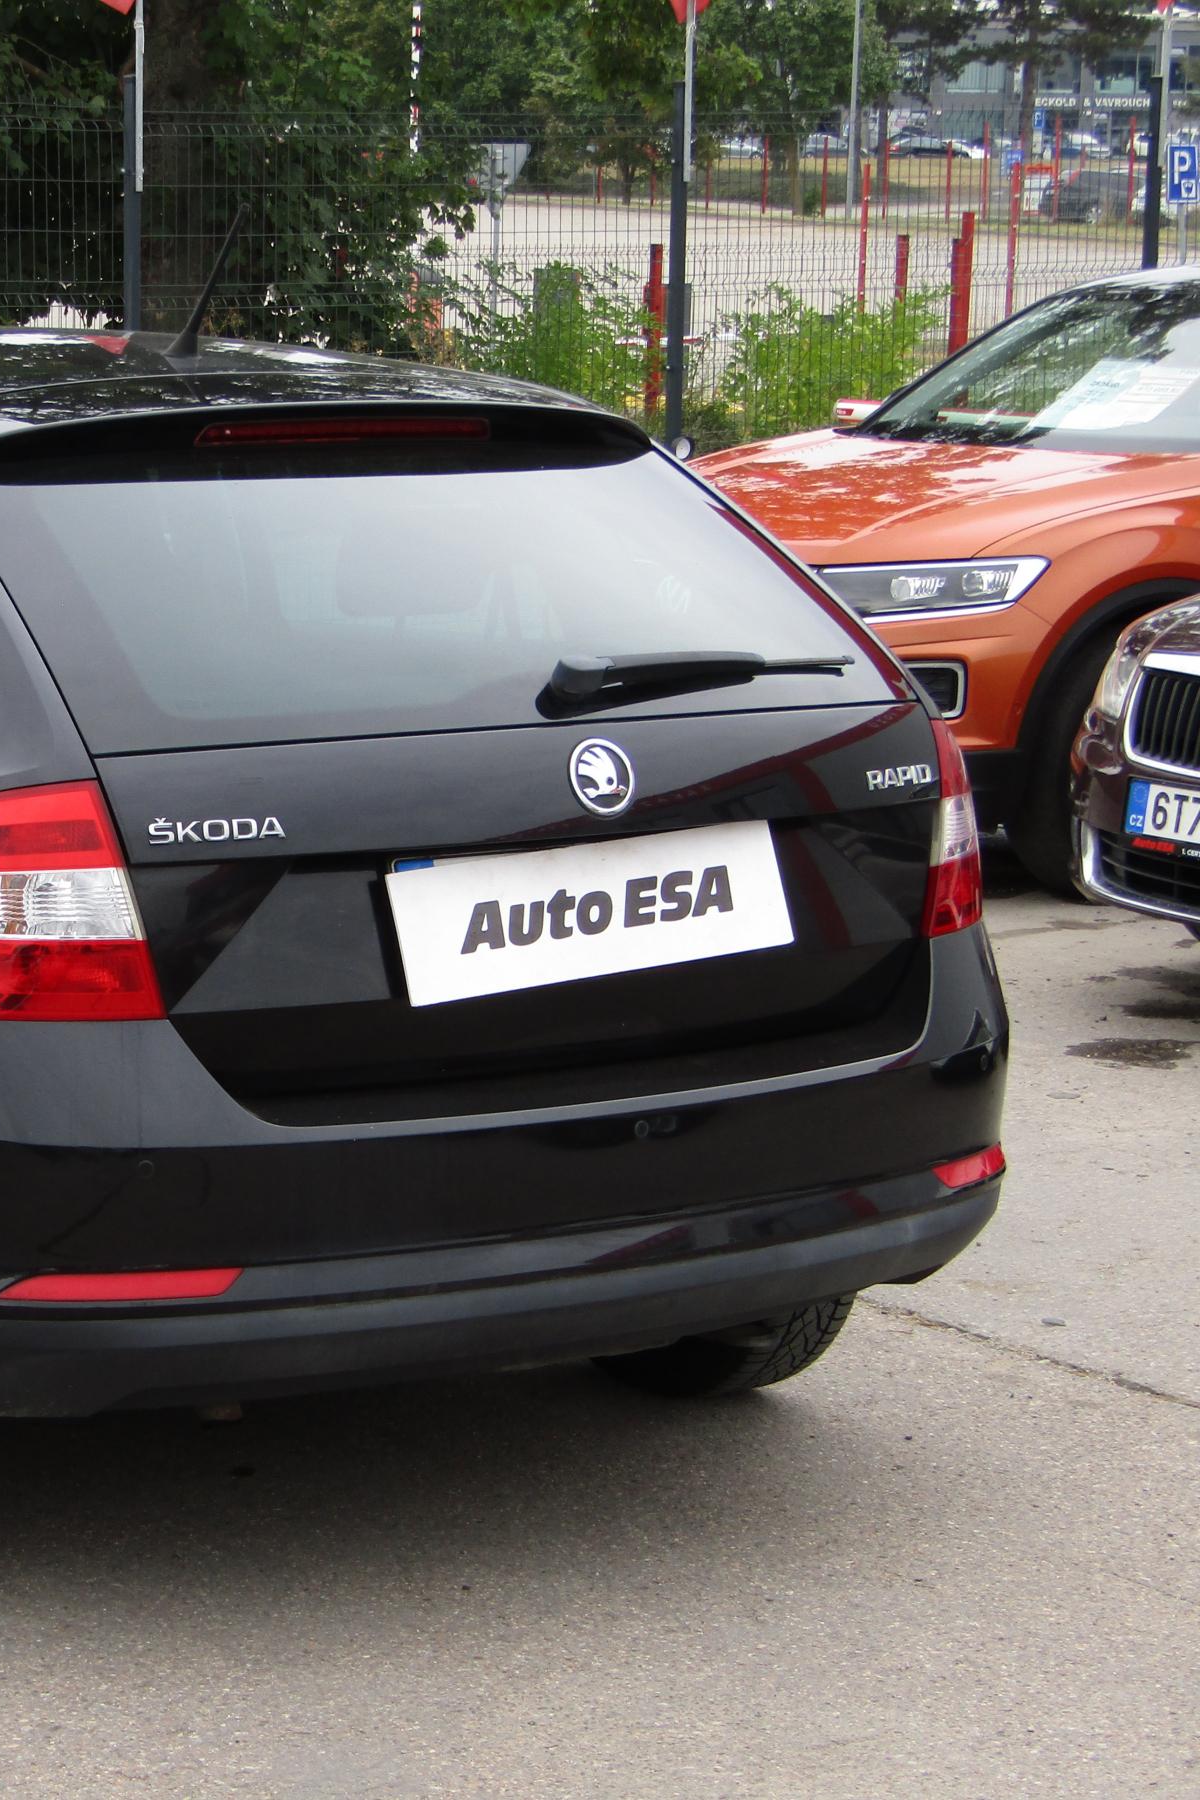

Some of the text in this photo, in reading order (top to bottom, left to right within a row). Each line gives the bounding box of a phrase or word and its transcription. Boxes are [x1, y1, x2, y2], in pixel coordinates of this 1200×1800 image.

[1083, 98, 1091, 107] &
[1174, 151, 1191, 184] P
[866, 764, 932, 791] RAPID
[148, 817, 287, 845] ŠKODA
[1129, 814, 1144, 827] CZ
[460, 865, 734, 954] Auto ESA
